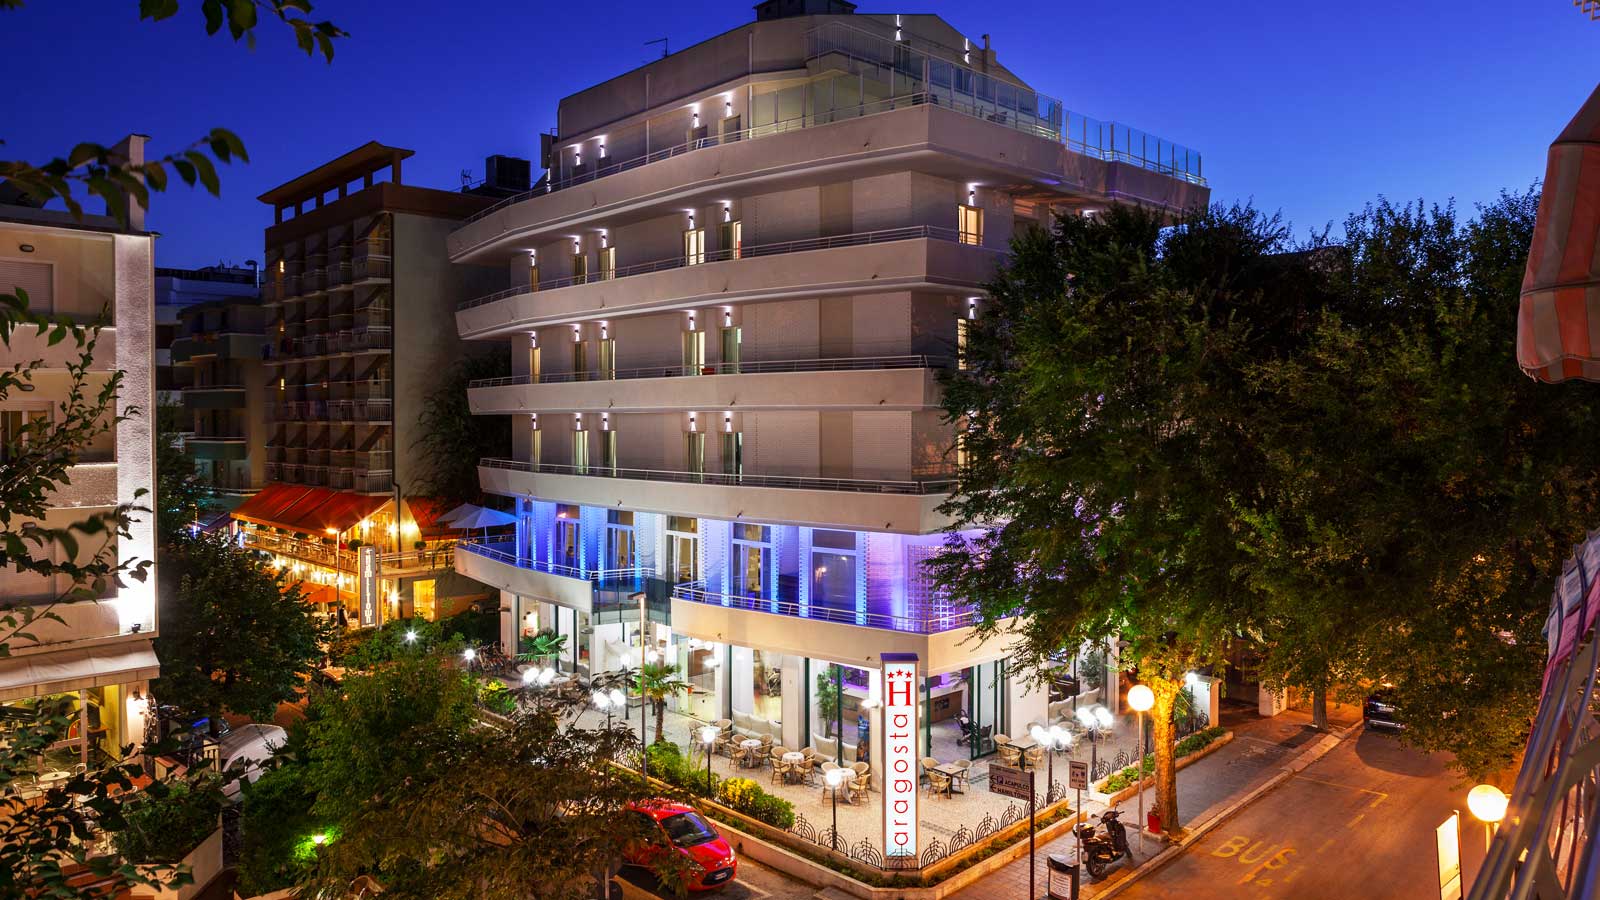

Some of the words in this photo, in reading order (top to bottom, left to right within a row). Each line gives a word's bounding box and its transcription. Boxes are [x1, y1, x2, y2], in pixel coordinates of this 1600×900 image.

[887, 681, 912, 706] H
[889, 713, 912, 846] aragosta
[1210, 835, 1297, 870] BUS
